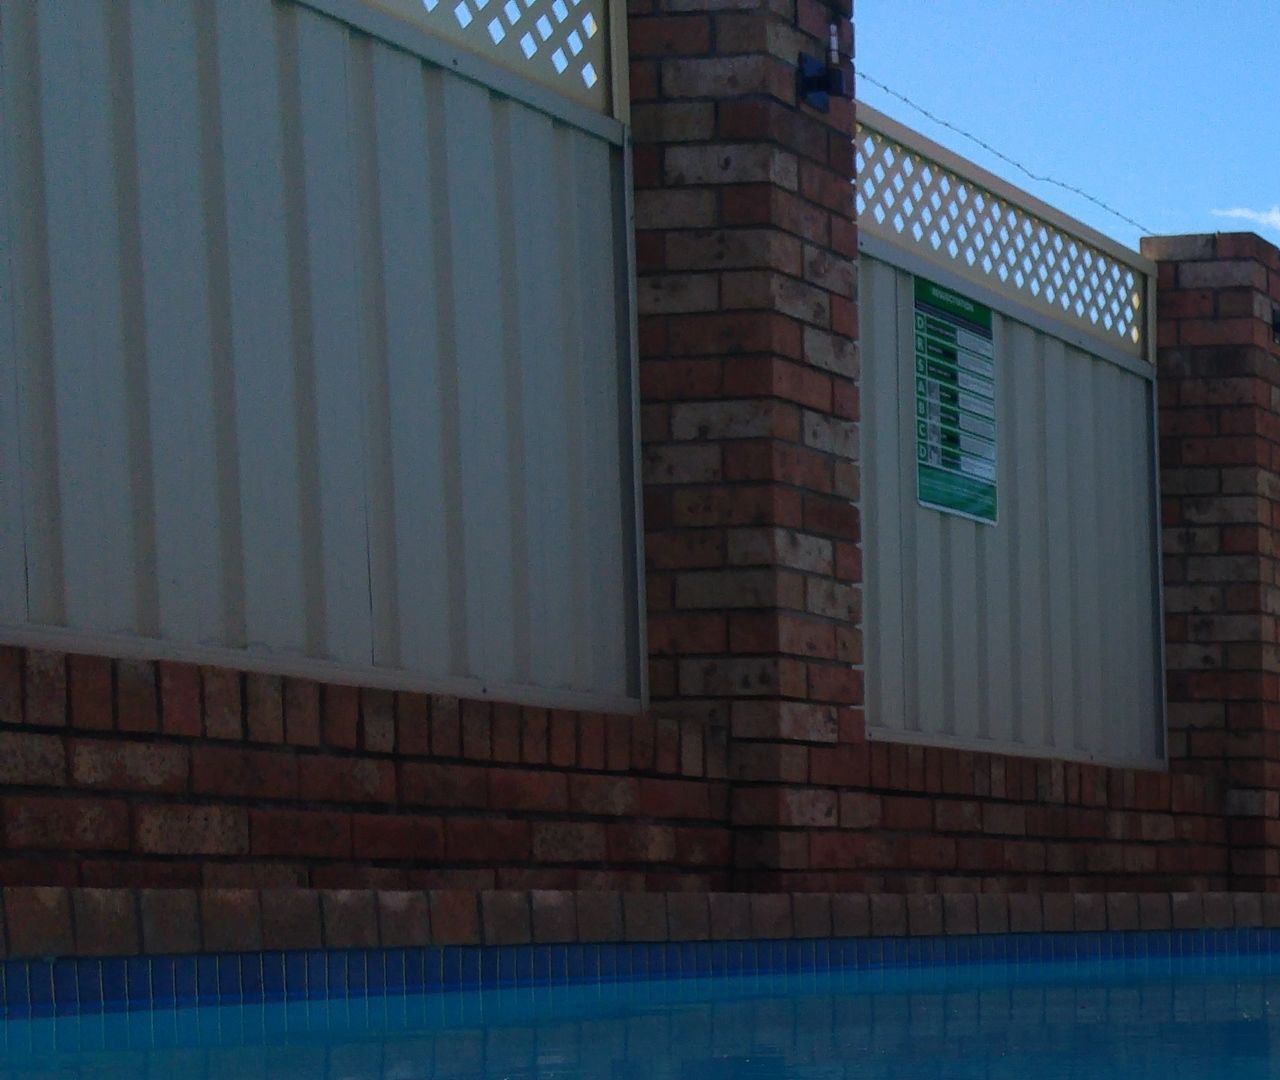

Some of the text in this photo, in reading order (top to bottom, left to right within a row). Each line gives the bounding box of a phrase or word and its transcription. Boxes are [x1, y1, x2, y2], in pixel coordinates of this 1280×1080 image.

[917, 316, 924, 329] D
[918, 358, 924, 372] S
[918, 380, 925, 393] A
[919, 423, 925, 437] C
